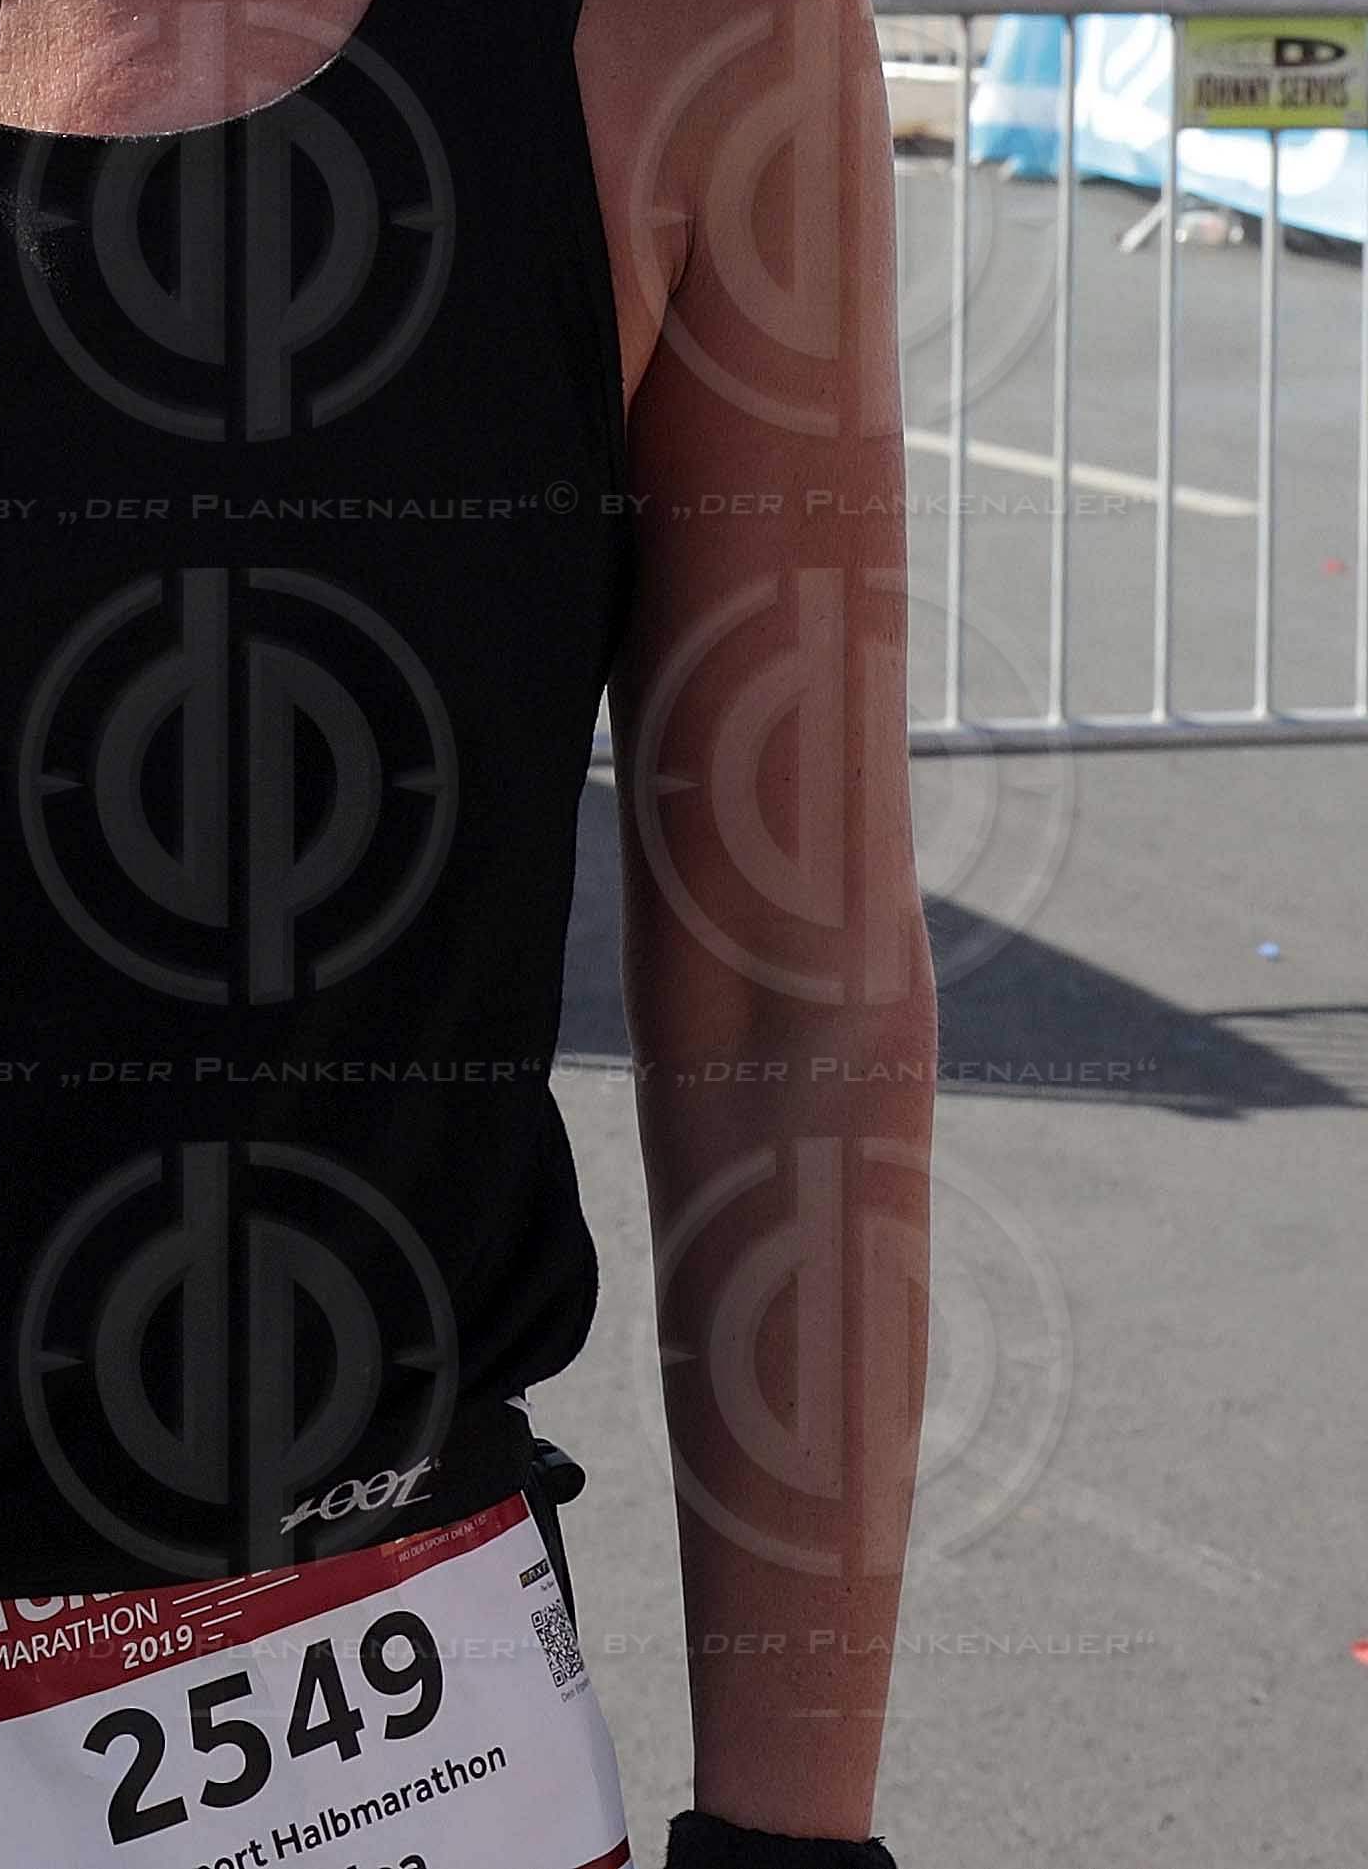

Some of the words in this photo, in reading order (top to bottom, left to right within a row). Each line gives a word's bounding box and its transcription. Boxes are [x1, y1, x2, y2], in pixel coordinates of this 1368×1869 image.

[122, 1624, 194, 1671] 2019
[82, 1609, 445, 1846] 2549
[270, 1744, 507, 1859] Halbmarathon
